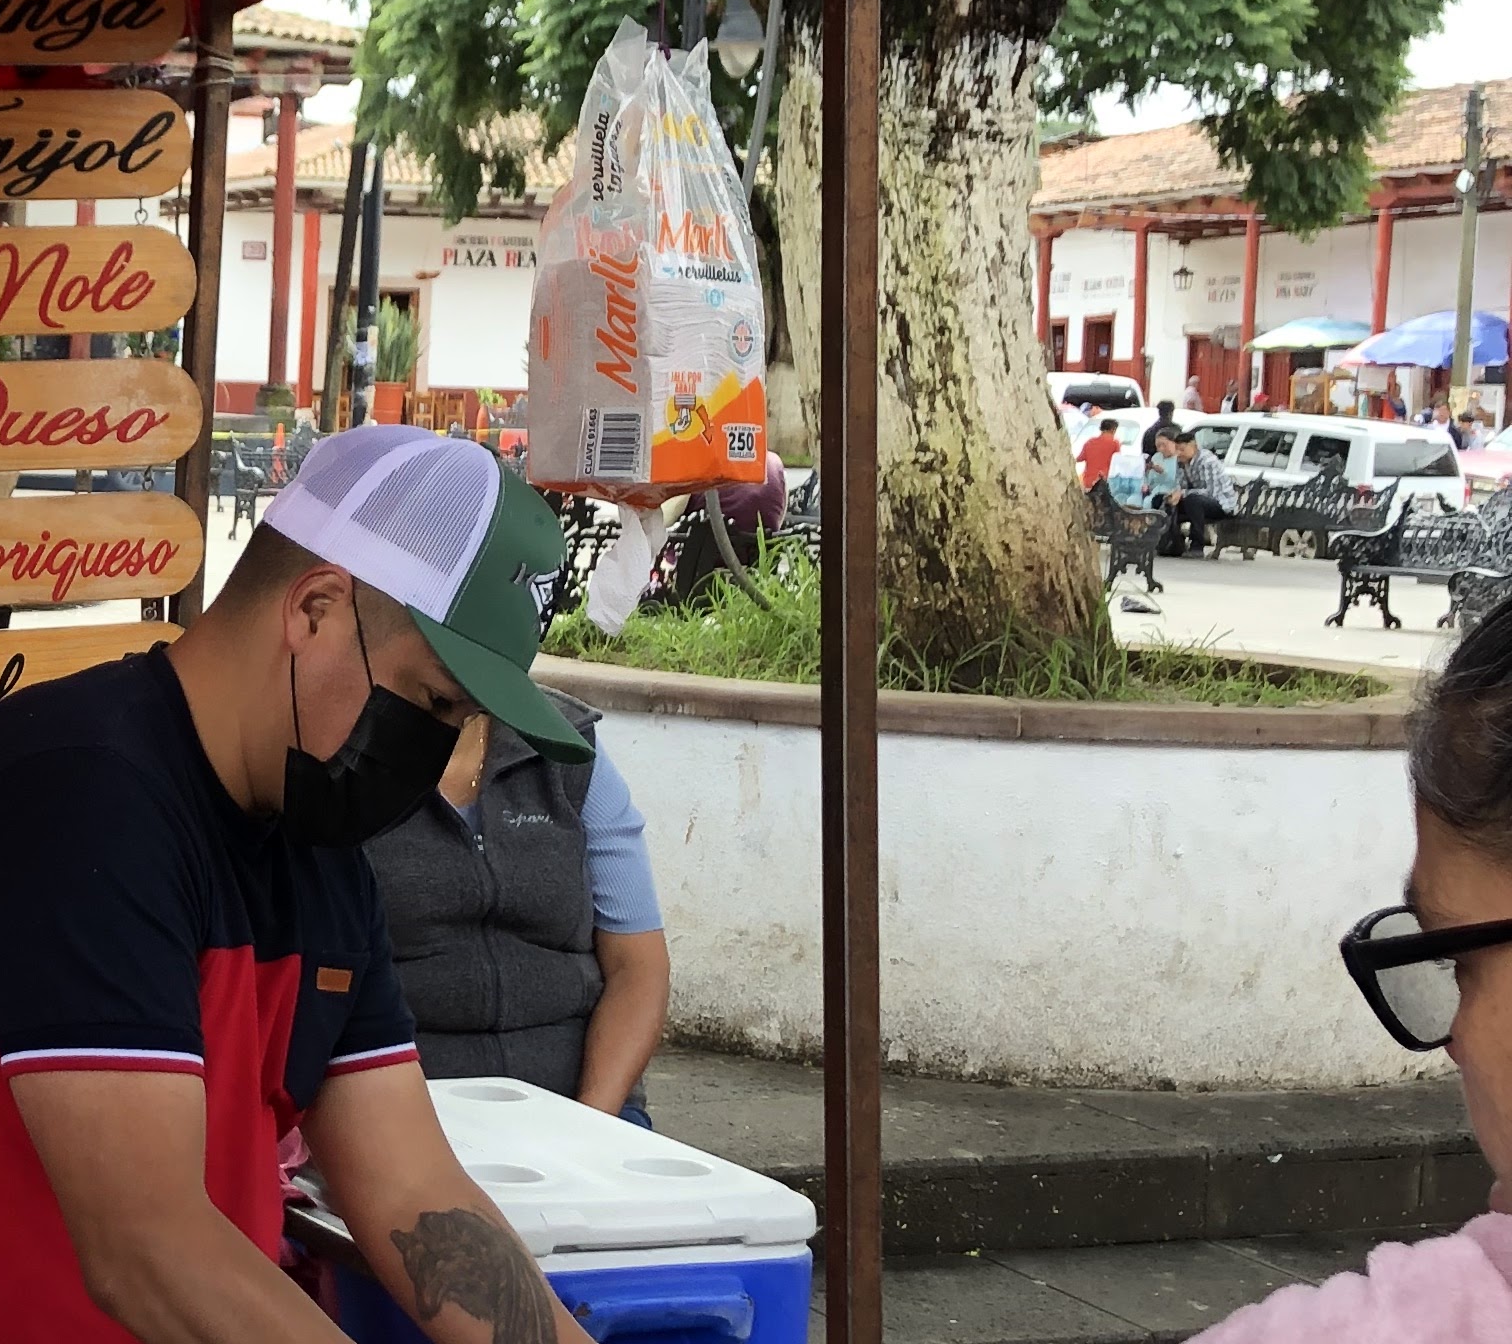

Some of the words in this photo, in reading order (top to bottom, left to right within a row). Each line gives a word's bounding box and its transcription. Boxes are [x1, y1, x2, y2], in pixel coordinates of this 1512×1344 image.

[442, 247, 497, 267] PLAZA
[505, 249, 537, 268] REA
[589, 247, 641, 395] Marli
[728, 432, 755, 452] 250
